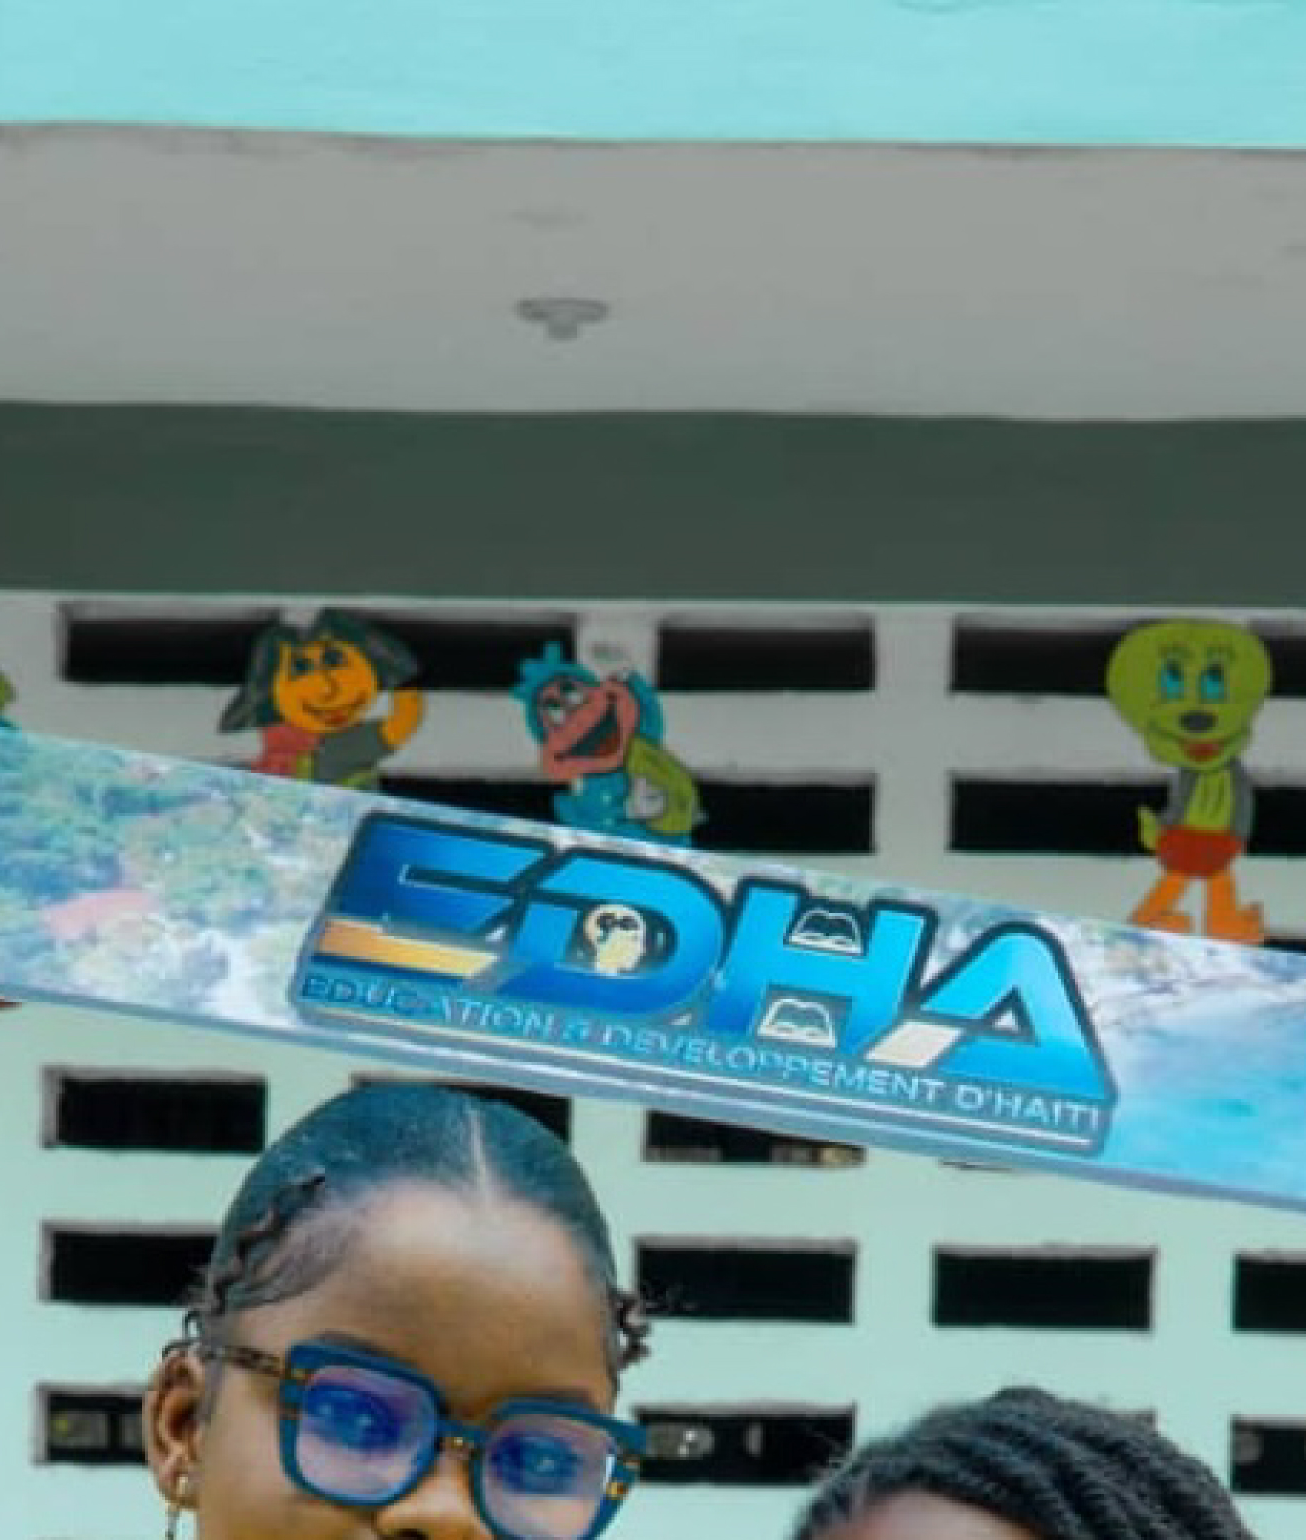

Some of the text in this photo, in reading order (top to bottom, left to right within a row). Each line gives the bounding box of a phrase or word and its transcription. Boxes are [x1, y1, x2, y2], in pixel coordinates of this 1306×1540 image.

[300, 972, 554, 1043] EDUCATION
[954, 1083, 1101, 1133] D'HAITI
[310, 815, 1111, 1104] EDHA
